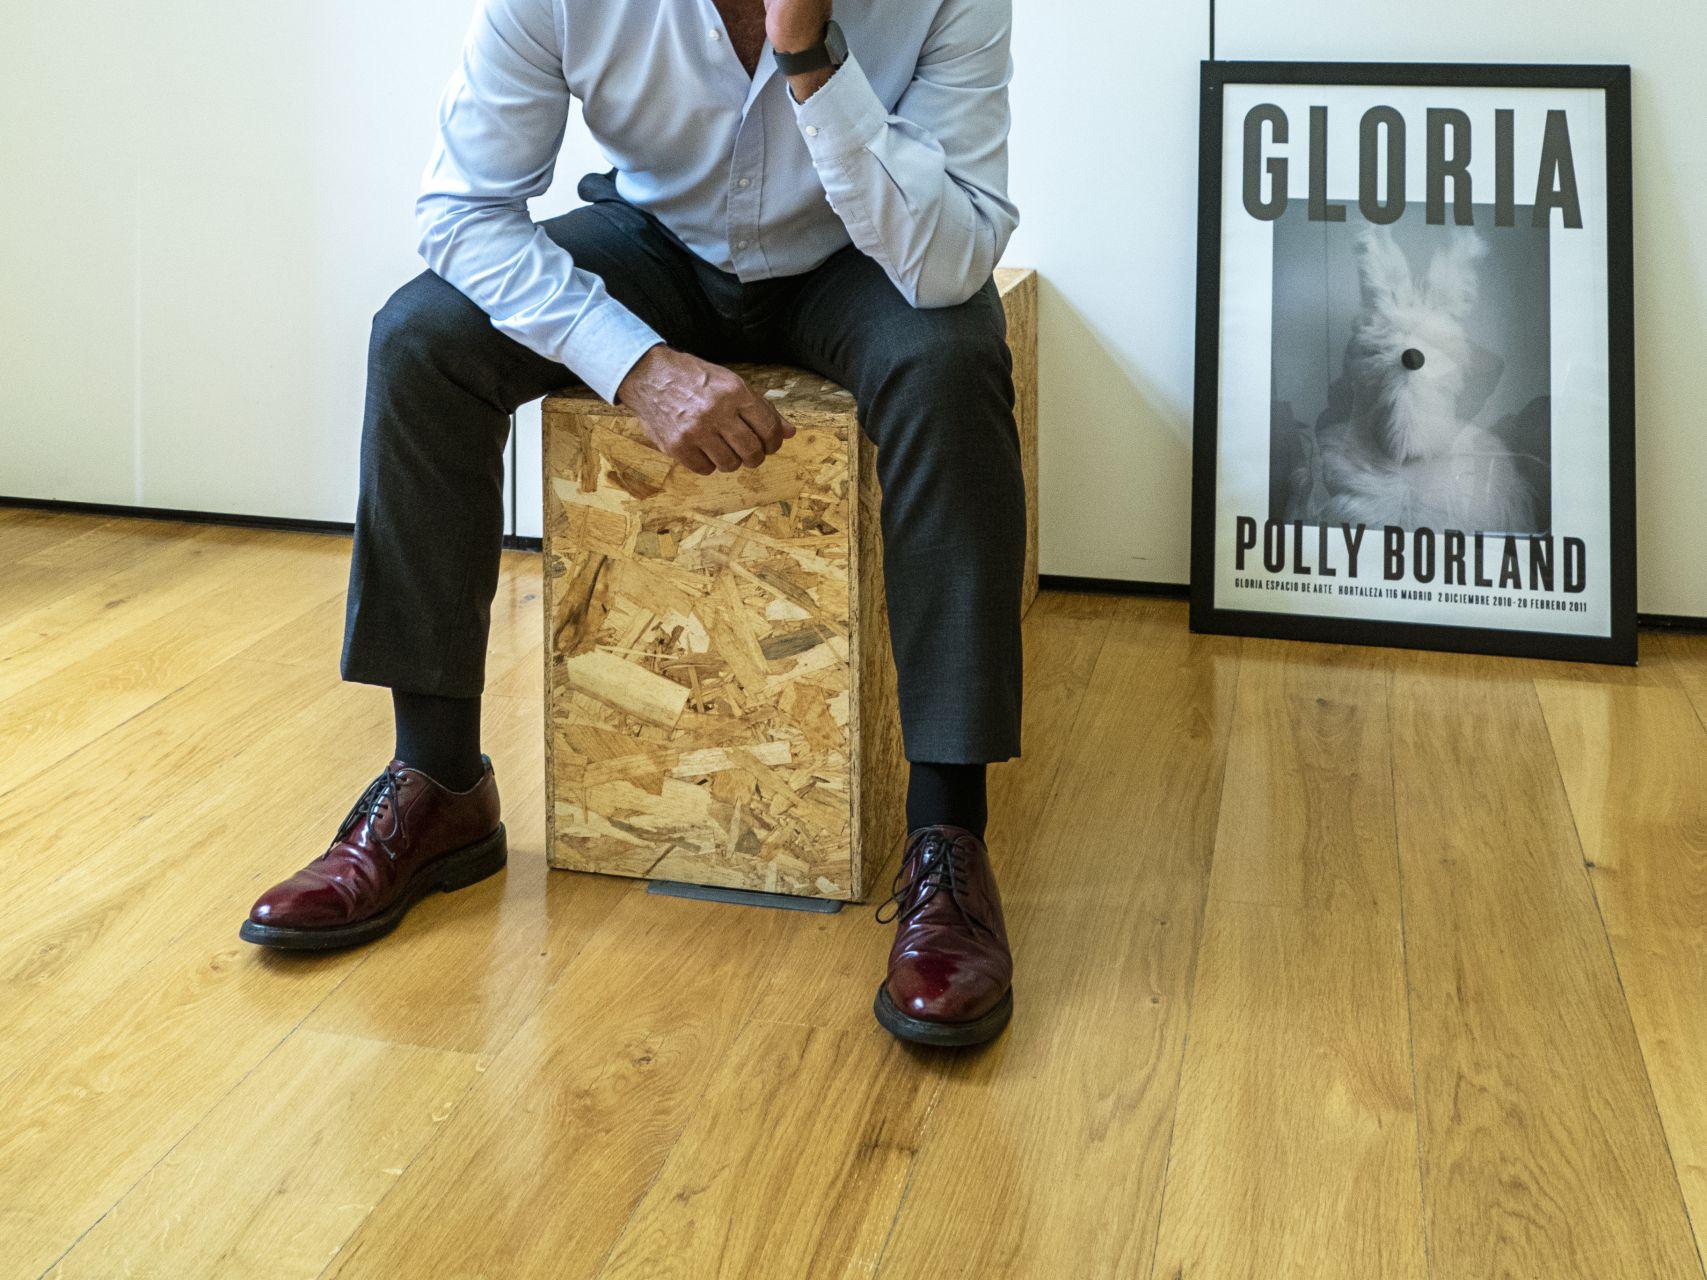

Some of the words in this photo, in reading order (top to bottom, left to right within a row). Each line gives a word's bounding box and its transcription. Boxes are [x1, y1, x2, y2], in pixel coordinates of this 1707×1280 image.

[1242, 103, 1583, 229] GLORIA
[1235, 516, 1366, 578] POLLY
[1383, 525, 1587, 594] BORLAND
[1235, 577, 1262, 589] GLORIA
[1266, 580, 1298, 592] ESPACIO
[1301, 583, 1310, 593] DE
[1313, 584, 1332, 594] ARTE
[1338, 586, 1383, 597] HORTALEZA
[1385, 589, 1398, 599] 116
[1401, 590, 1432, 601] MADRID
[1445, 593, 1490, 605] DICIEMBRE
[1530, 599, 1566, 611] FEBRERO
[1569, 602, 1587, 612] 2011
